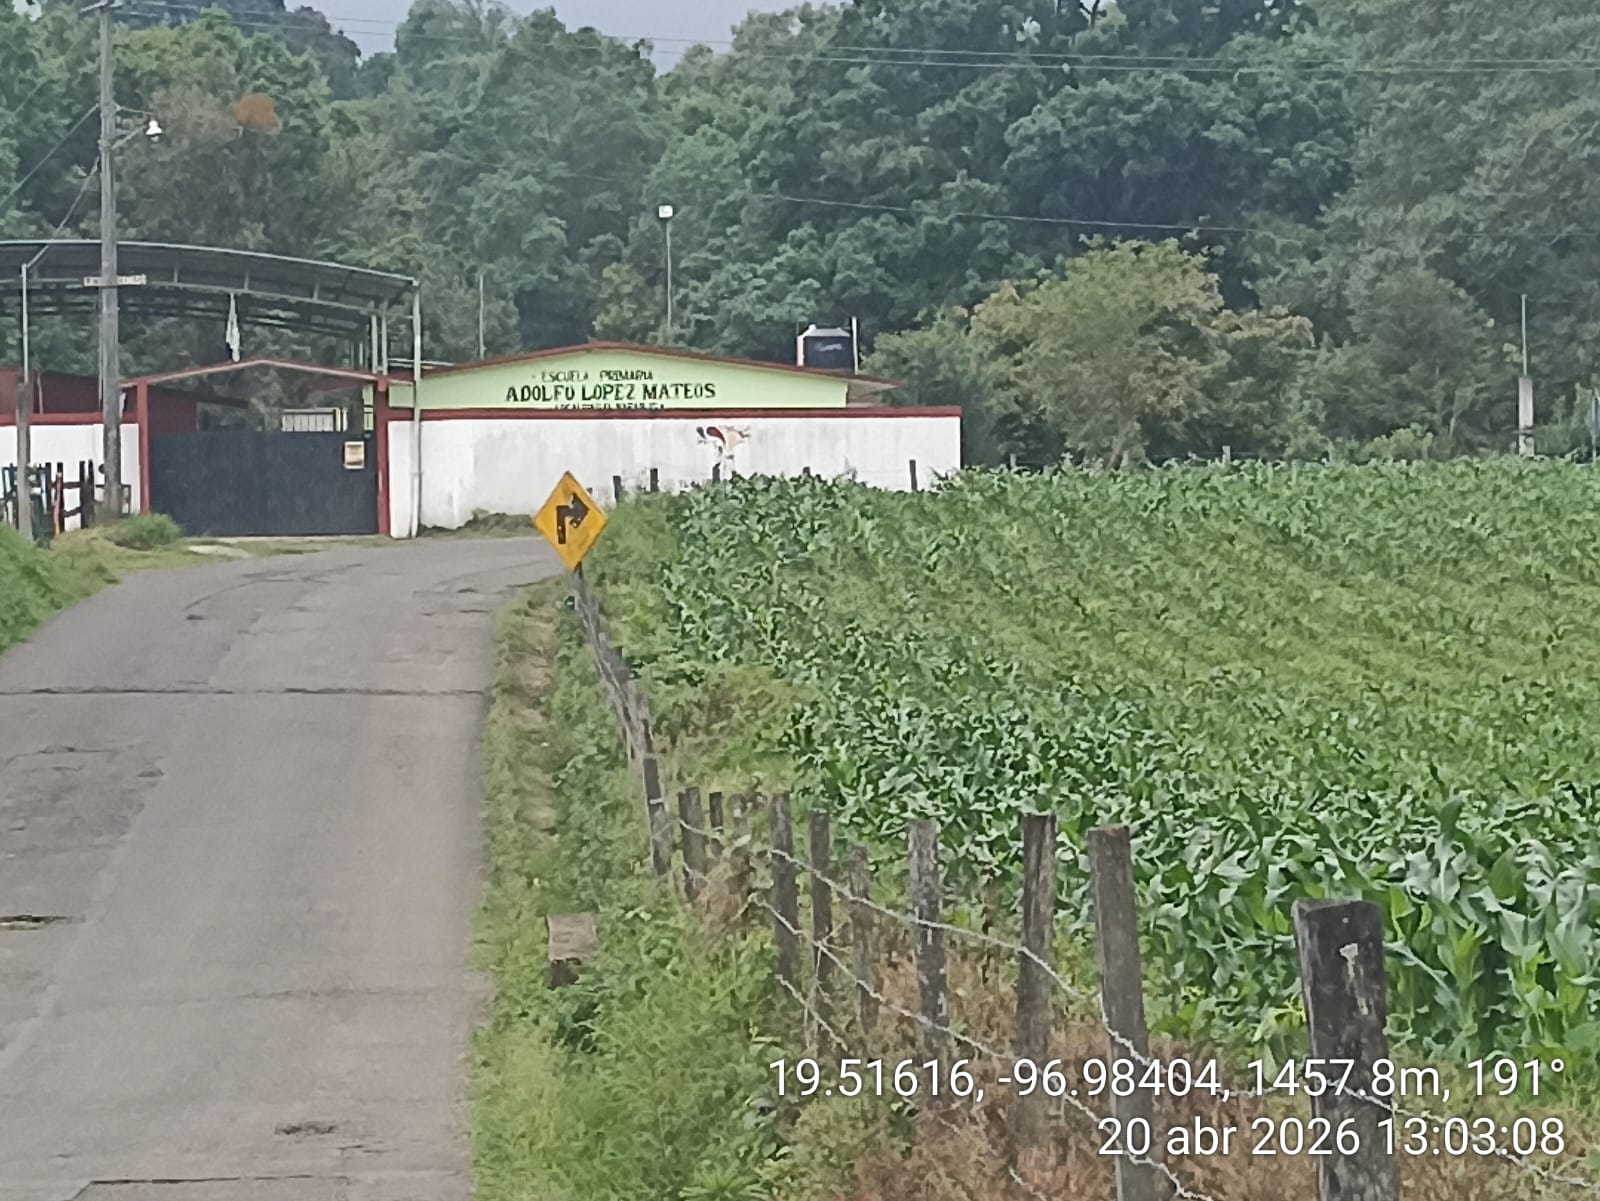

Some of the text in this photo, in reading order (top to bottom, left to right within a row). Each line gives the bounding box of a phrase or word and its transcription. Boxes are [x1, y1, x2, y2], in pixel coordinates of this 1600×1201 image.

[541, 369, 654, 382] ESCUELA PRIMARIA
[506, 382, 716, 402] ADOLFO LOPEZ MATEOS
